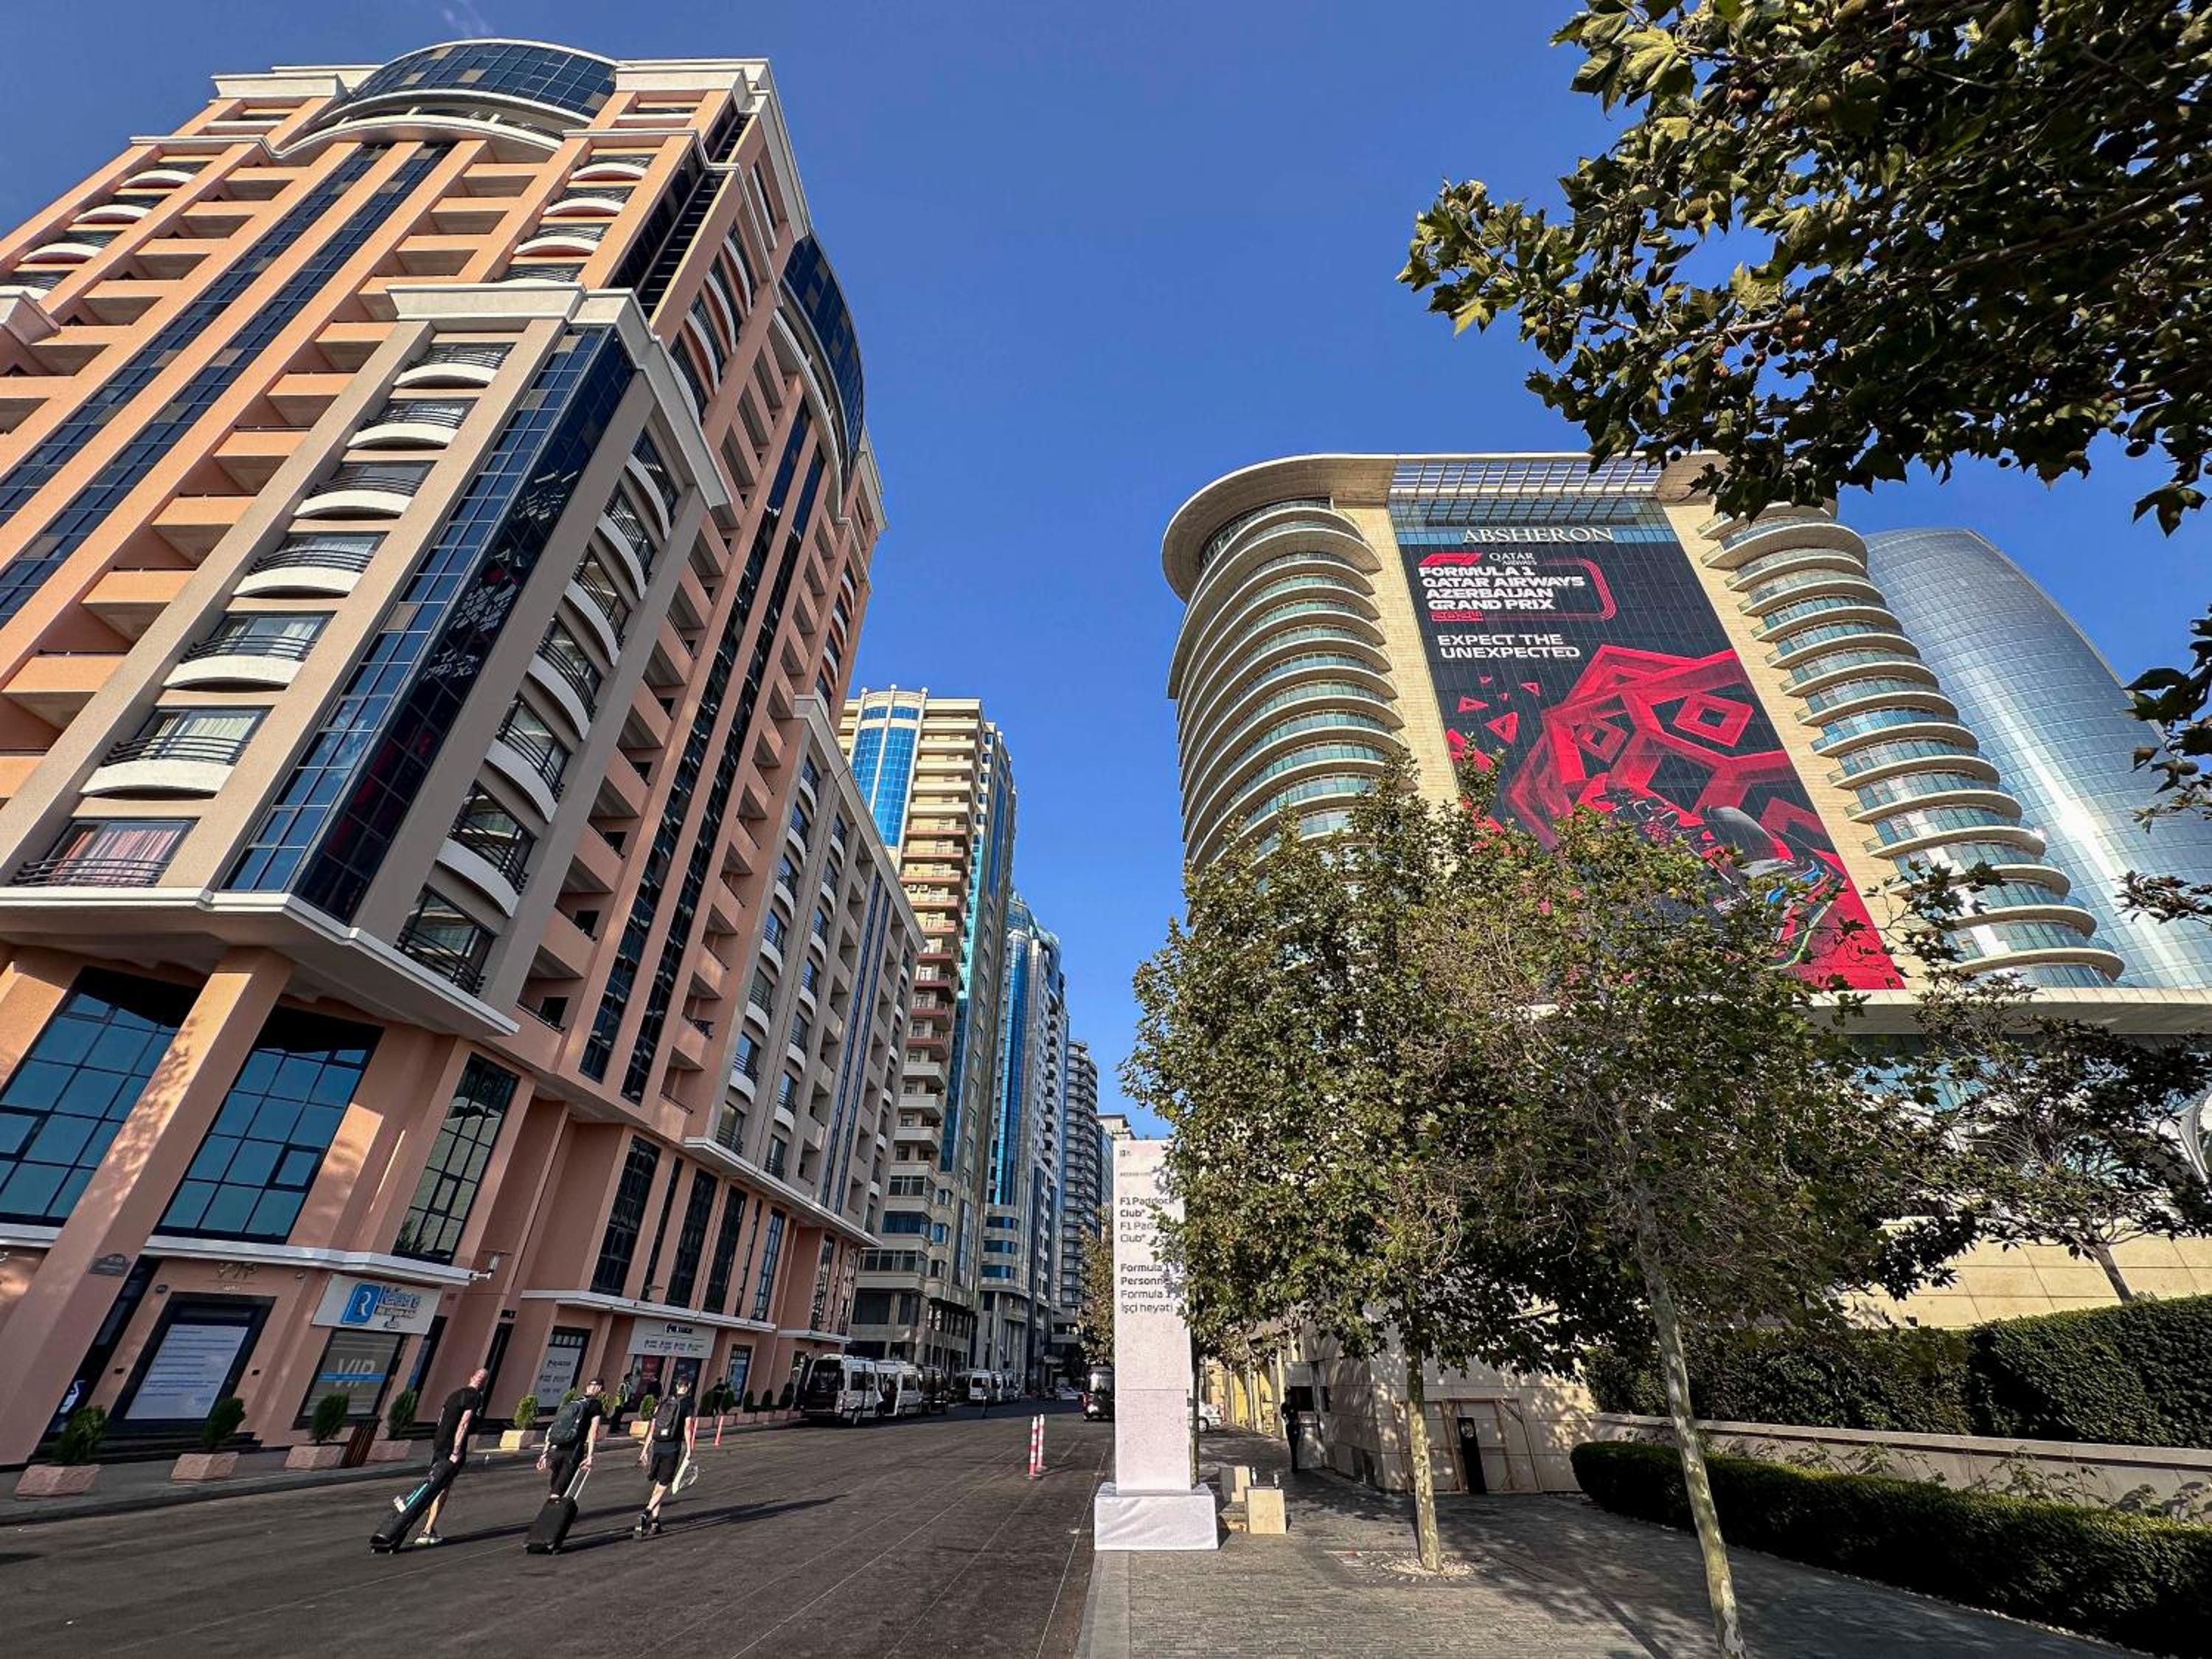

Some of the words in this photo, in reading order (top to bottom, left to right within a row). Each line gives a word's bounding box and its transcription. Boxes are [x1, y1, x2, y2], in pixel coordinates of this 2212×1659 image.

[1463, 527, 1614, 543] ABSHERON
[1489, 552, 1534, 562] QATAR
[1419, 567, 1520, 577] FORMULA
[1523, 566, 1535, 576] 1
[1422, 577, 1491, 588] QATAR
[1493, 576, 1585, 588] AIRWAYS
[1426, 588, 1554, 599] AZERBAIJAN
[1428, 599, 1502, 610] GRAND
[1504, 599, 1556, 609] PRIX
[1438, 634, 1514, 646] EXPECT
[1518, 633, 1564, 645] THE
[1441, 646, 1581, 658] UNEXPECTED
[1120, 1197, 1131, 1206] F1
[1120, 1222, 1132, 1231] F1
[1120, 1264, 1163, 1272] Formula
[1120, 1290, 1164, 1298] Formula
[335, 1358, 377, 1388] VIP
